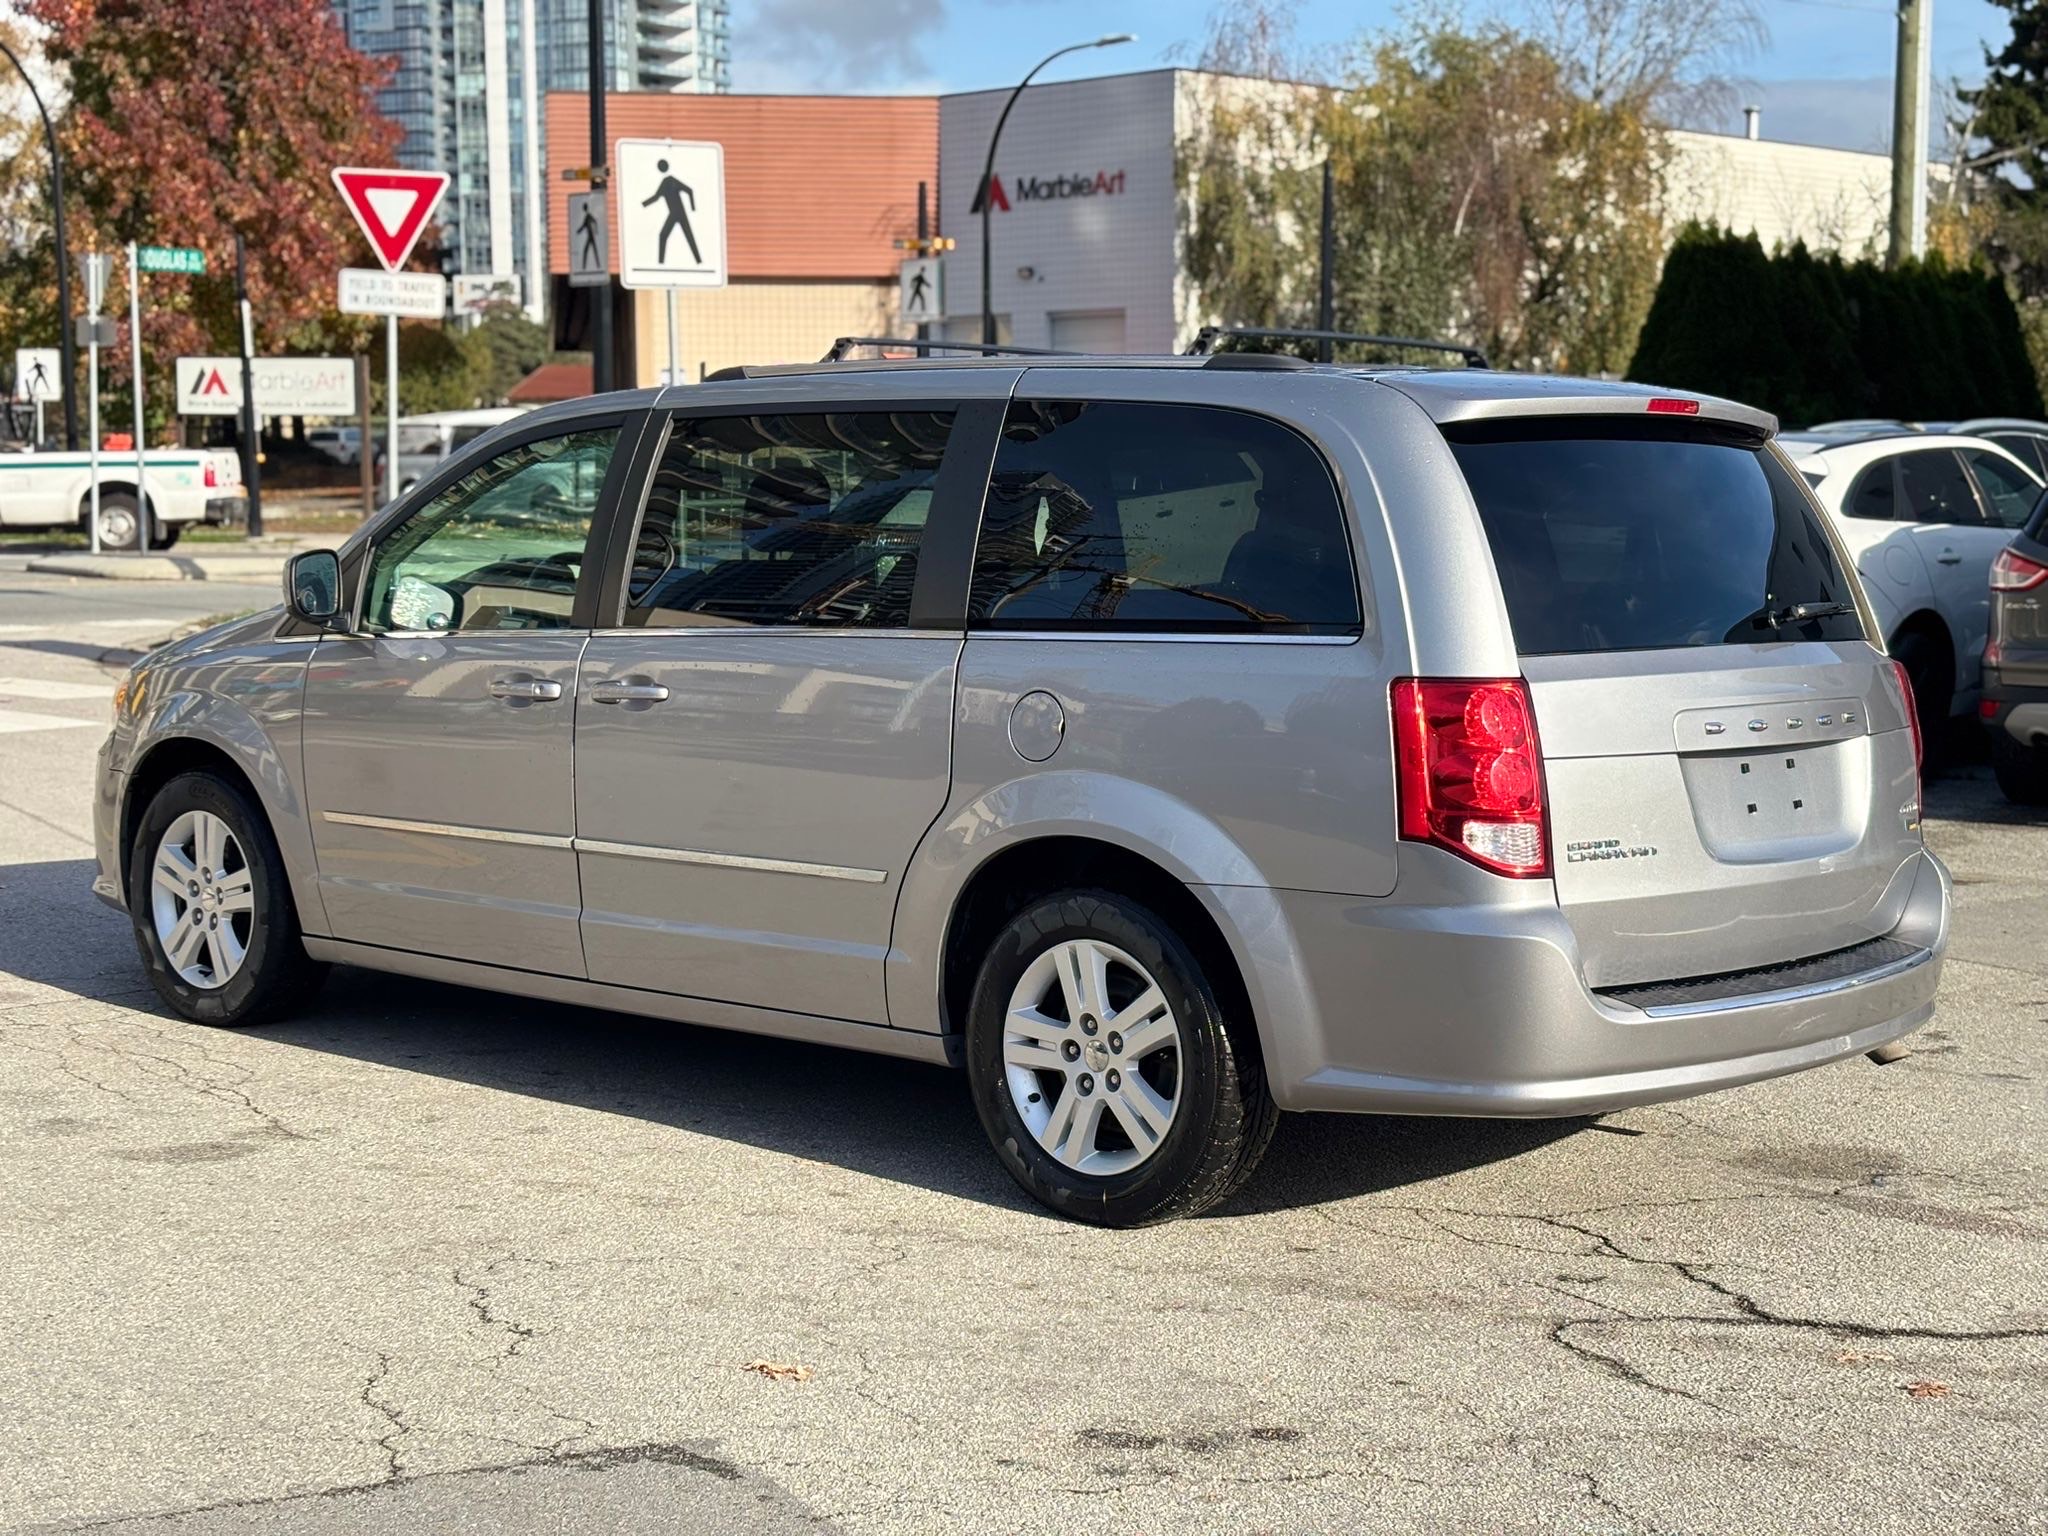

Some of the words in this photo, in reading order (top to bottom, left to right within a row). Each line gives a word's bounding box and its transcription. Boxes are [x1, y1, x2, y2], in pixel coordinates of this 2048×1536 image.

[1016, 170, 1126, 201] MarbleArt
[240, 370, 345, 391] arbleArt
[1704, 711, 1856, 736] DODGE
[1567, 839, 1620, 852] GRAND
[1568, 846, 1658, 863] CARAVAN
